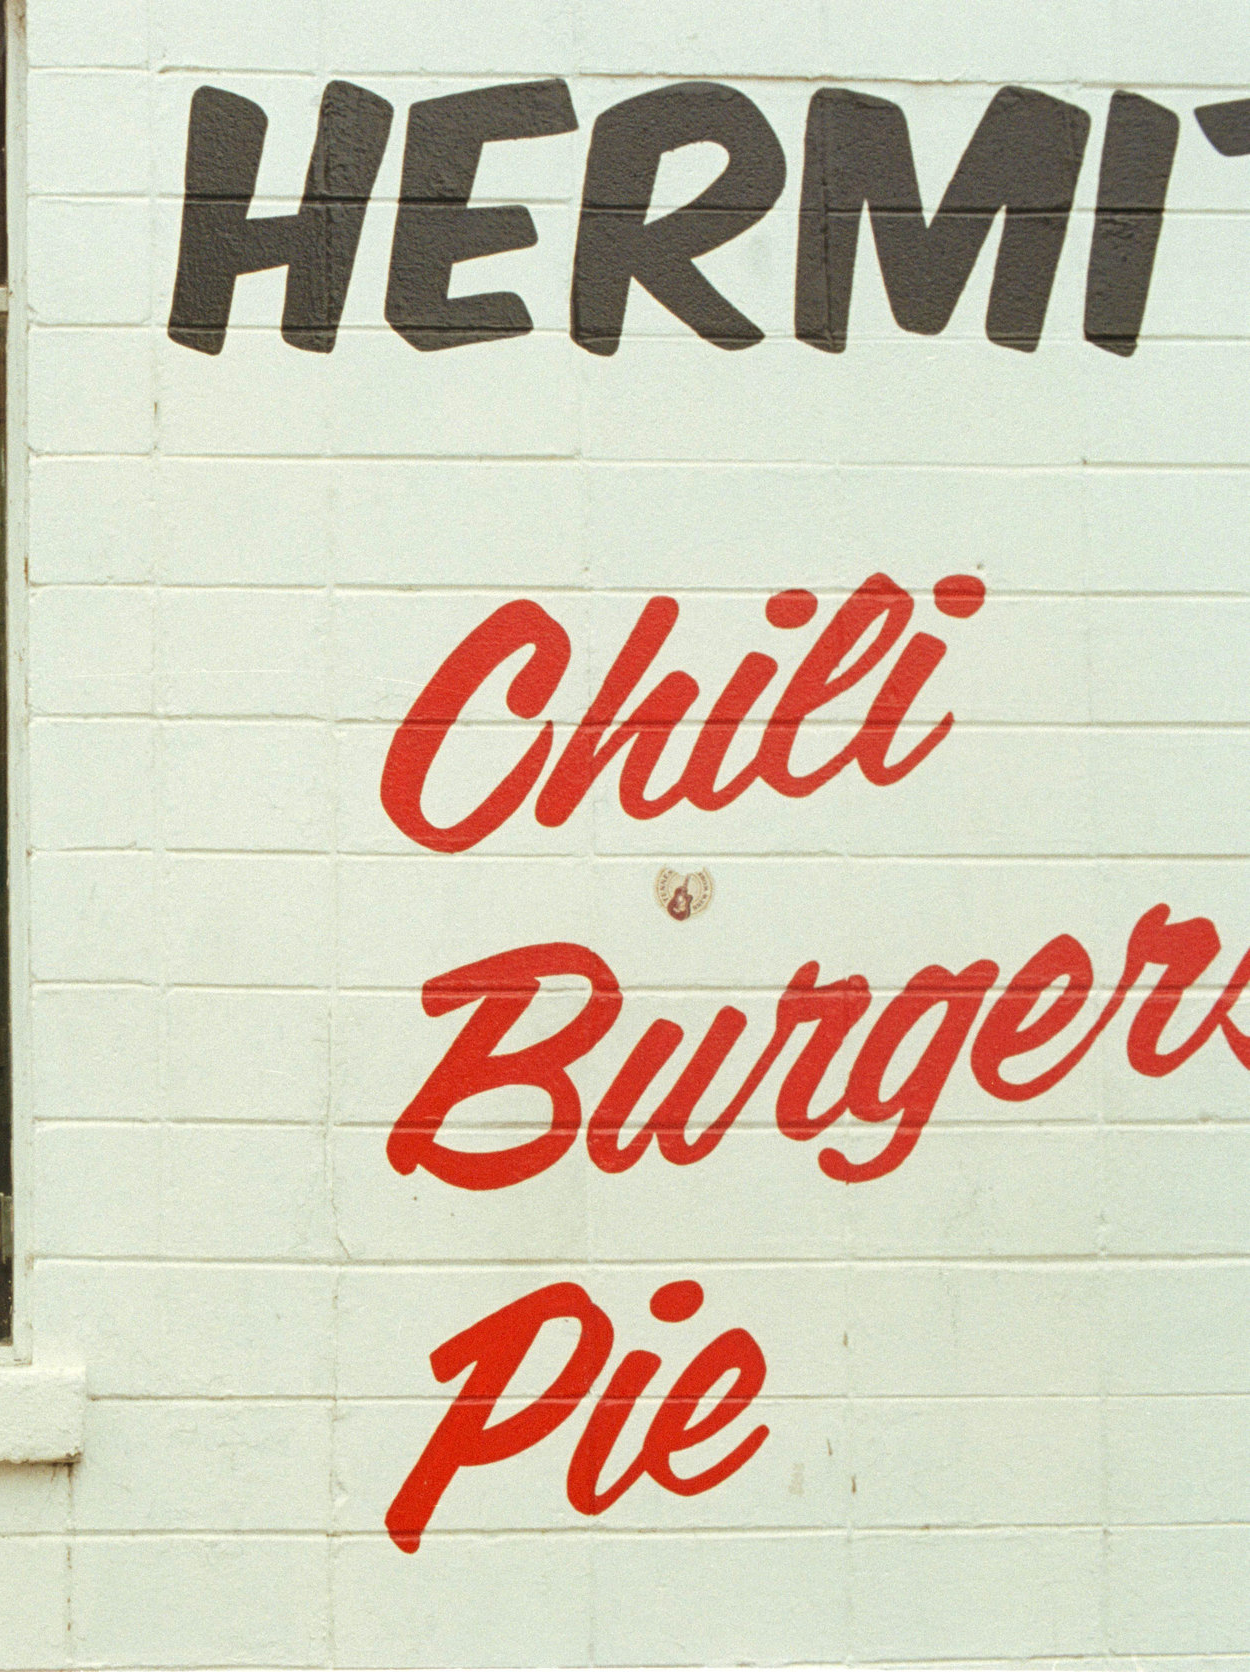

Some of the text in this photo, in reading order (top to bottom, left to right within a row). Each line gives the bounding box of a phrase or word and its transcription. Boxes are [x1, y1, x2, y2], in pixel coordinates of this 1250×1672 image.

[167, 79, 1250, 356] HERMI
[380, 572, 986, 854] Chili
[385, 1279, 770, 1554] Pie
